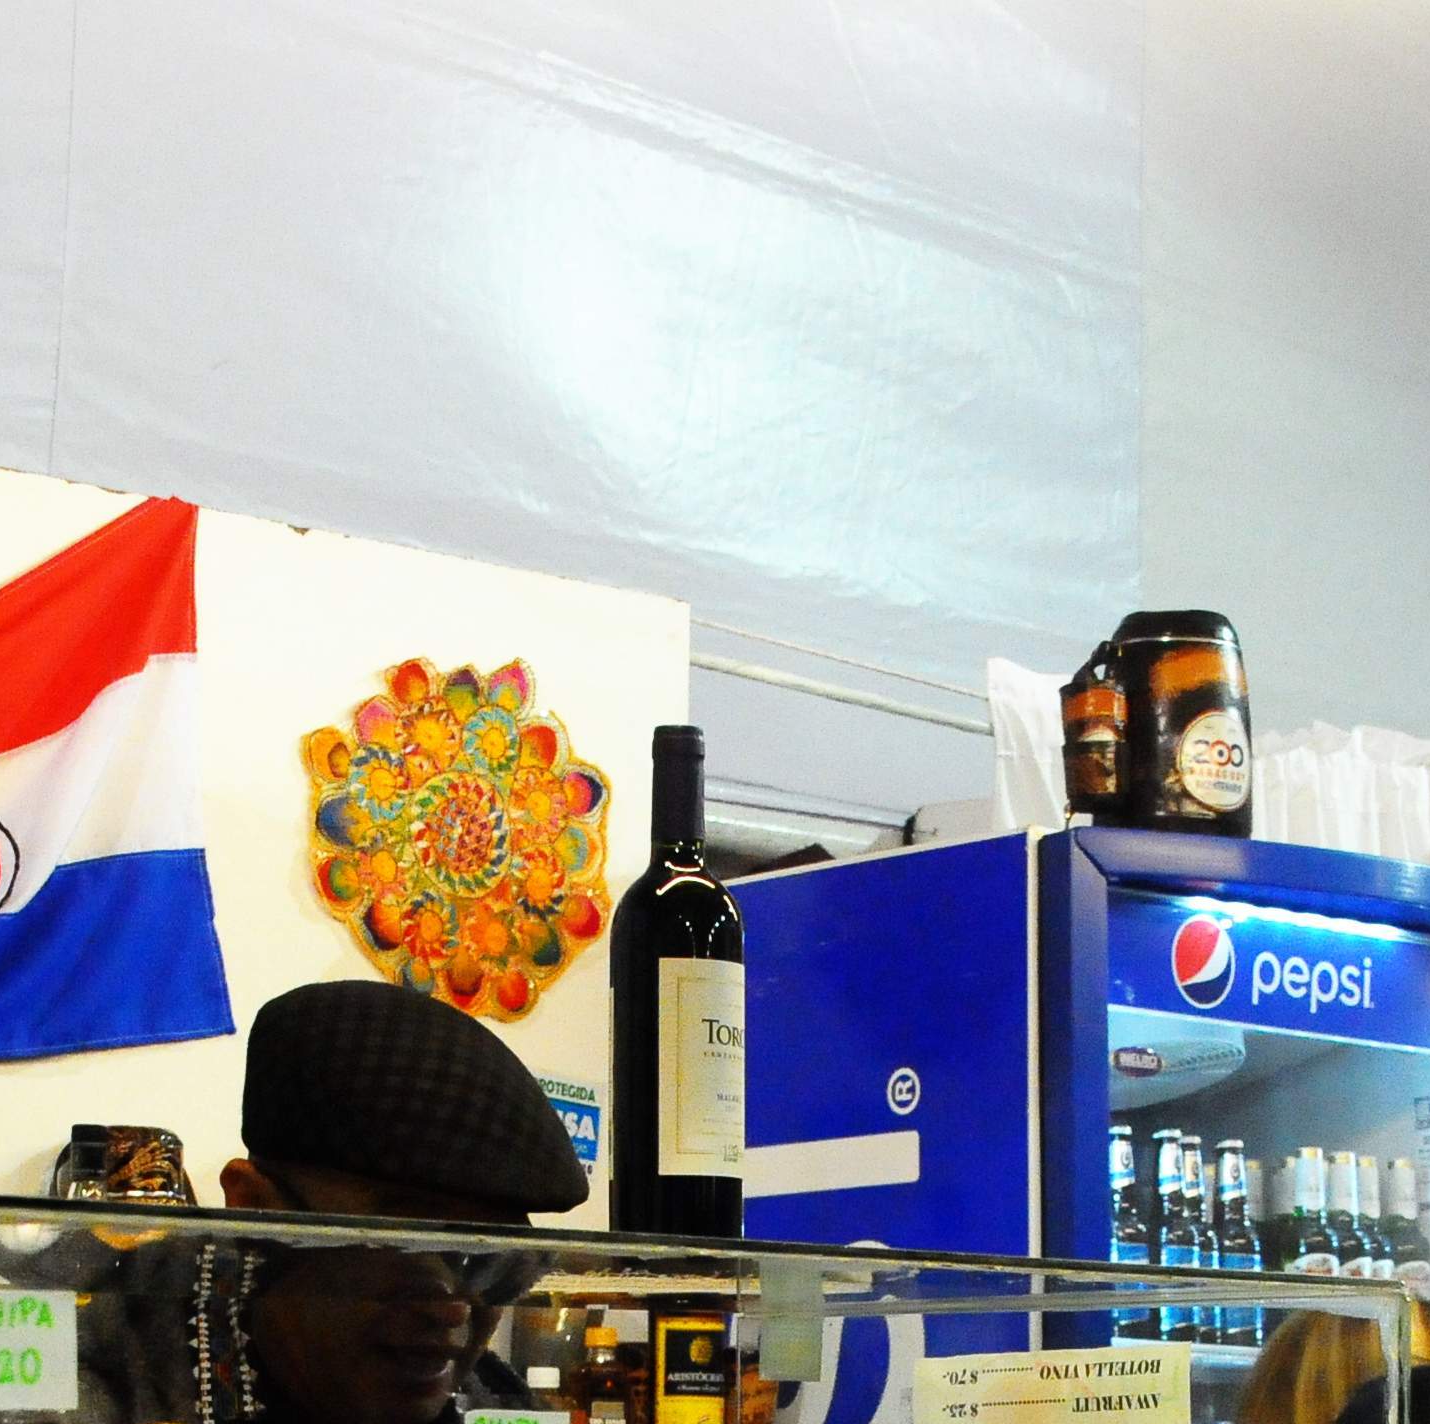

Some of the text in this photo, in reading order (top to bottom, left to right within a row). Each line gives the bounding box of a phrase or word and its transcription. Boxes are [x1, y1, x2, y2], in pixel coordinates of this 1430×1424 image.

[1192, 738, 1244, 769] 200
[1251, 951, 1374, 1014] pepsi
[1039, 1366, 1081, 1380] VINO
[1084, 1359, 1161, 1378] BOTELLA
[1072, 1393, 1160, 1412] AWAFRUIT
